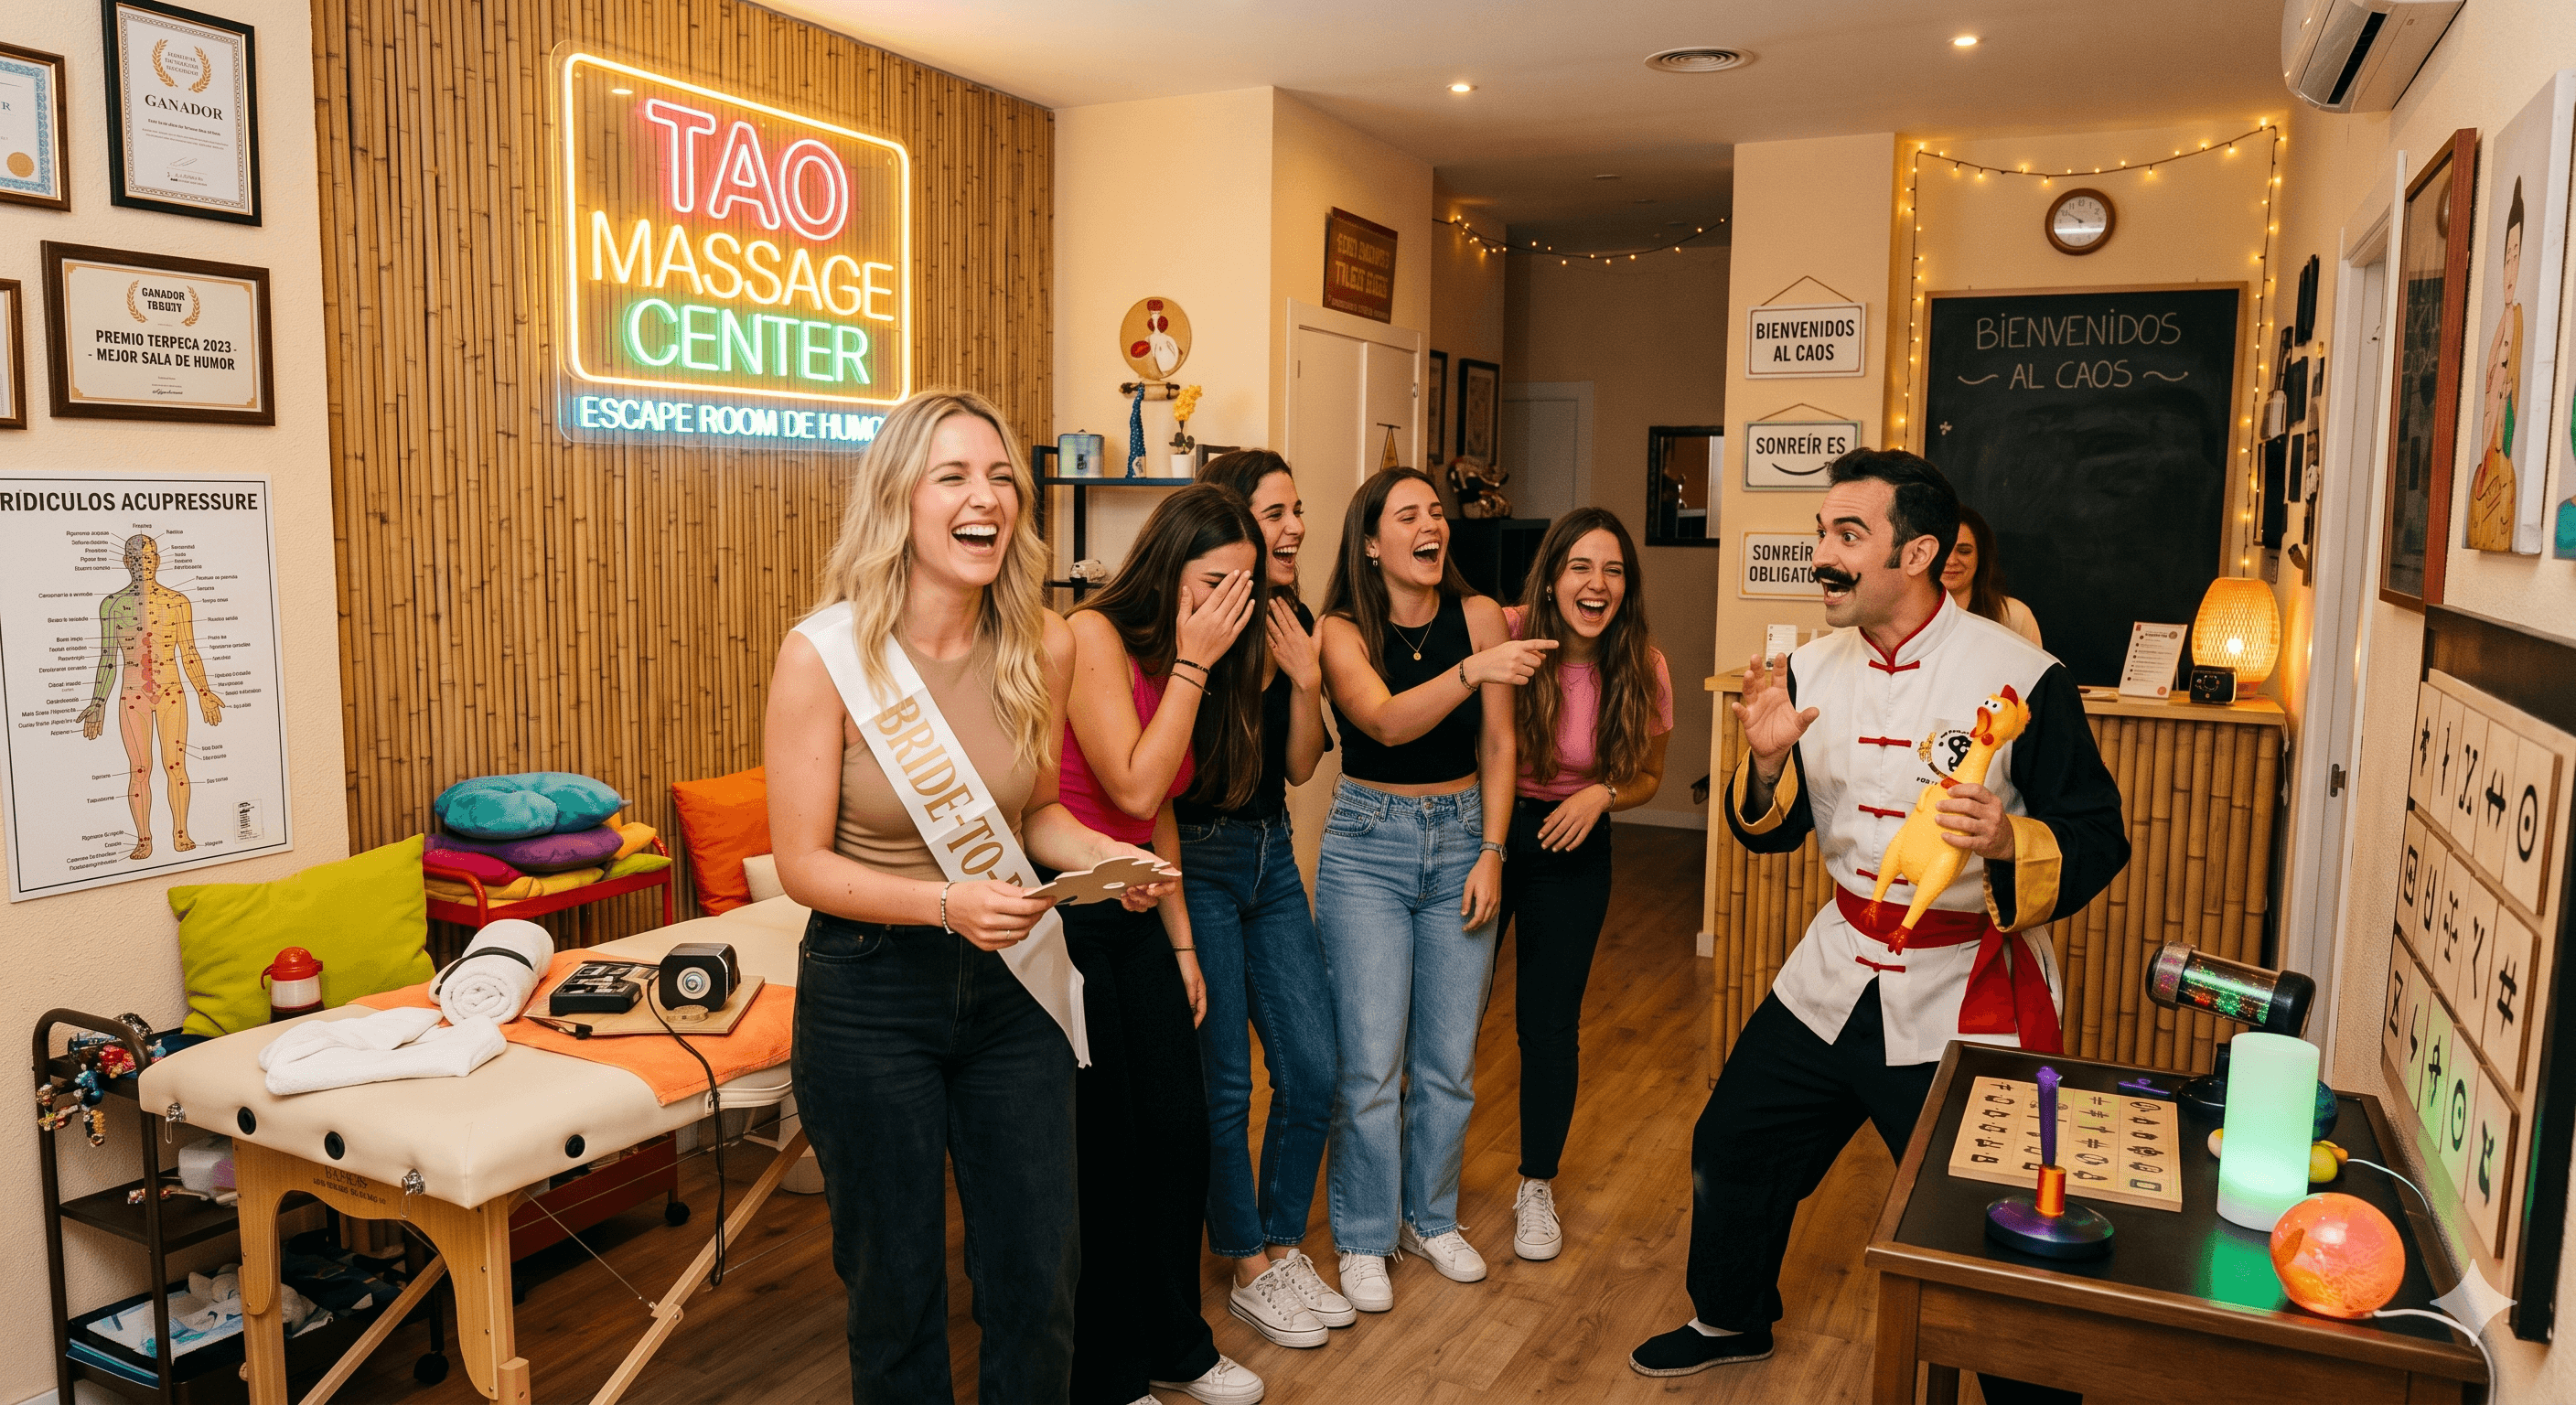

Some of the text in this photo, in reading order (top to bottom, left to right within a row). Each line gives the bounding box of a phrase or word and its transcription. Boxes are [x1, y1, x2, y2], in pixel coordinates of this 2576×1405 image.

[145, 94, 223, 121] GANADOR
[645, 98, 849, 241] TAO
[590, 210, 895, 321] MASSAGE
[142, 287, 185, 301] GANADOR
[96, 329, 144, 347] PREMIO
[147, 334, 199, 351] TERPECA
[203, 339, 231, 353] 2023
[626, 298, 870, 384] CENTER
[1756, 319, 1855, 339] BIENVENIDOS
[97, 348, 138, 363] MEJOR
[142, 351, 172, 366] SALA
[176, 354, 190, 368] DE
[194, 355, 235, 370] HUMOR
[1773, 343, 1835, 362] AL CAOS
[2009, 359, 2132, 391] AL CAOS
[580, 395, 886, 441] ESCAPE ROOM DE HUMO
[1755, 433, 1846, 455] SONREÍR ES
[121, 492, 258, 511] ACUPRESSURE
[1749, 565, 1816, 584] OBLIGATO
[872, 694, 1023, 888] BRIDE-TO-
